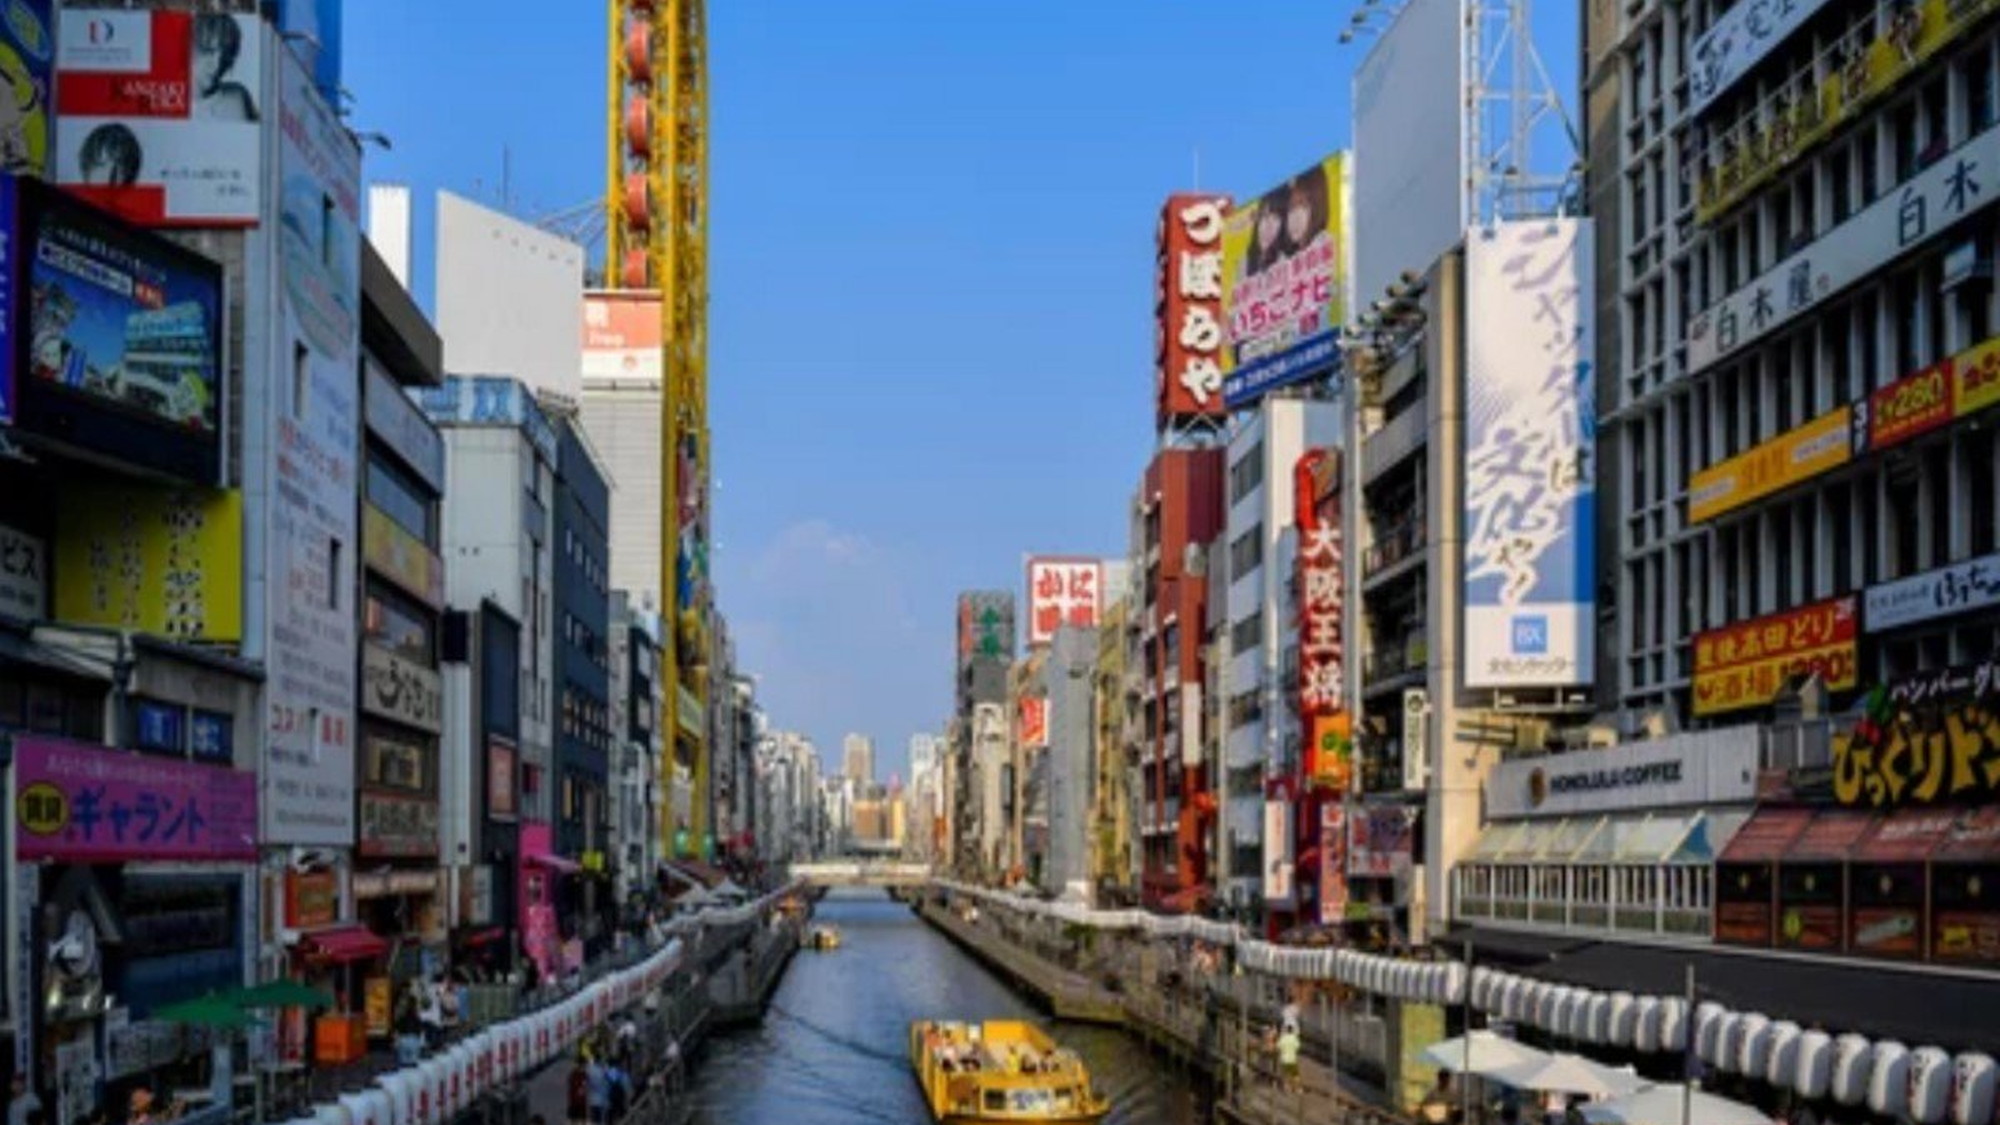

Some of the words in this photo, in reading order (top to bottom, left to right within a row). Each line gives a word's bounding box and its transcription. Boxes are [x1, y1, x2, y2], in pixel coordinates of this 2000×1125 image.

[1302, 520, 1342, 709] 大阪王将
[1624, 759, 1683, 785] COFFEE
[72, 785, 205, 844] ギャラント
